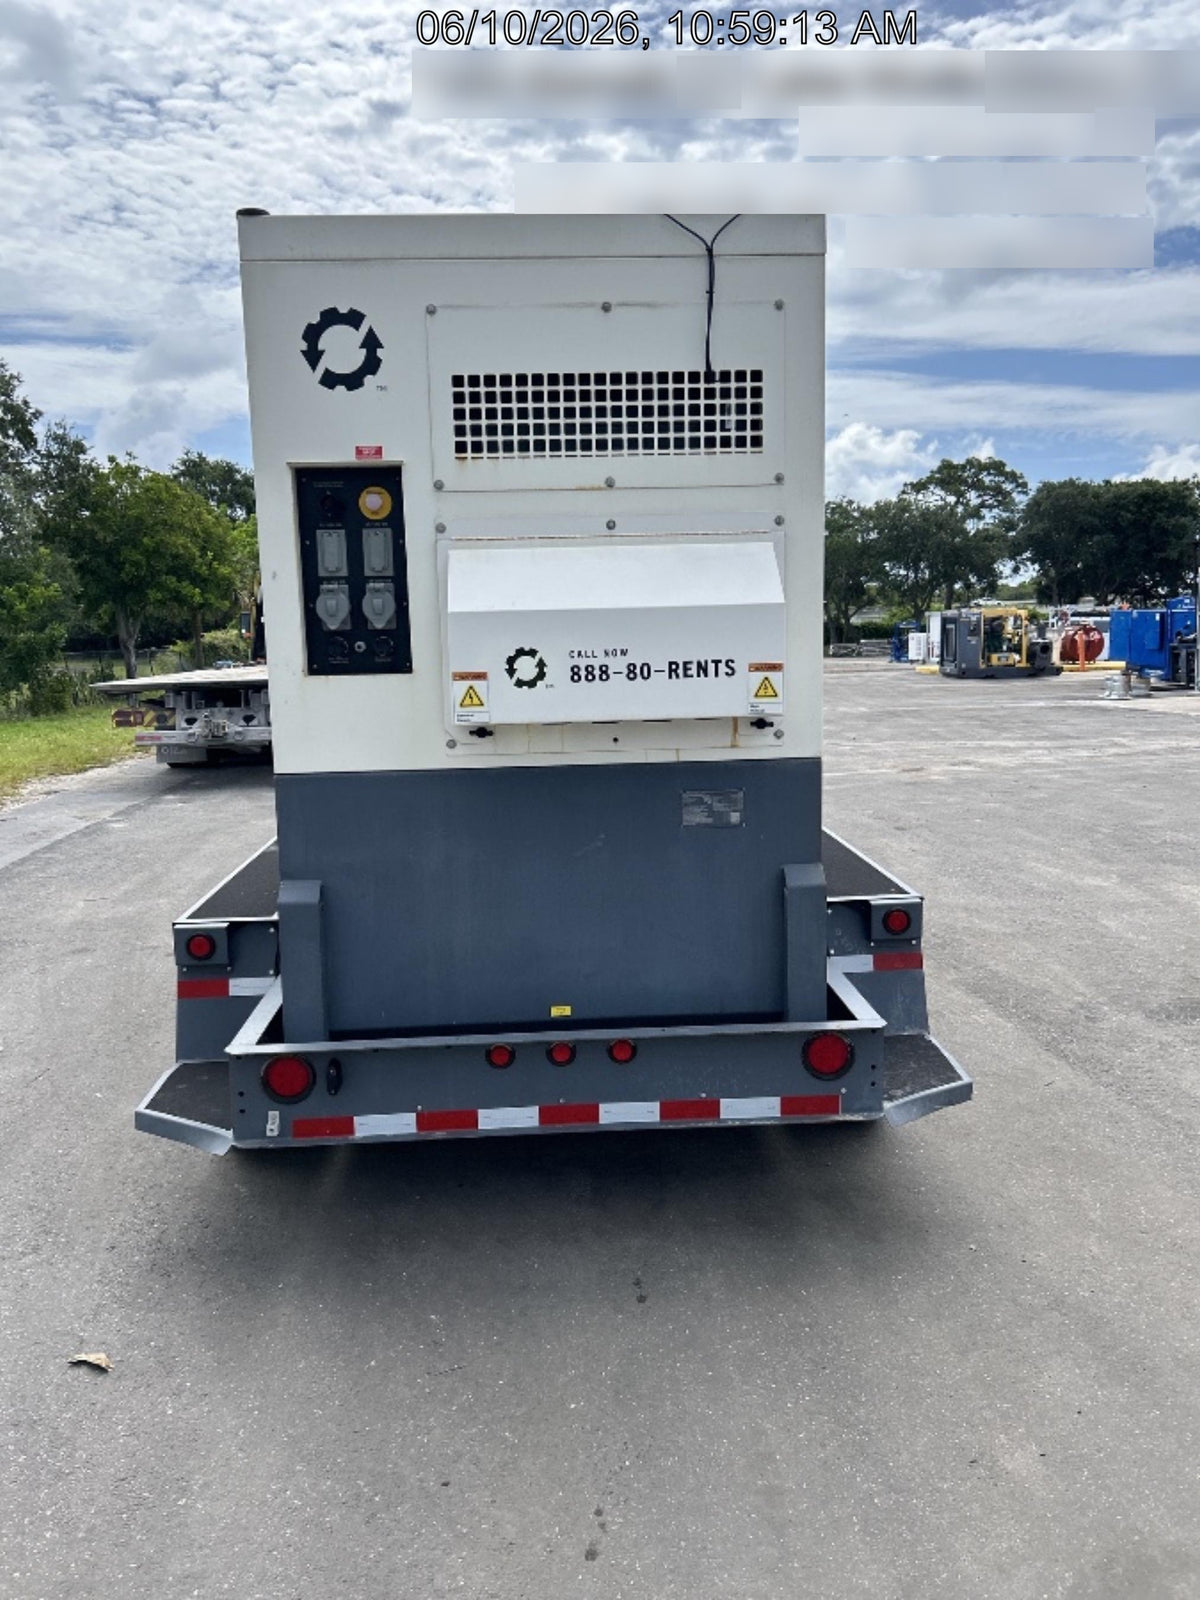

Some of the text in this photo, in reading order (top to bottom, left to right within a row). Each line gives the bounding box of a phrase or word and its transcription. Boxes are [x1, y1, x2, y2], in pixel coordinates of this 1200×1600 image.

[568, 648, 629, 659] CALL NOW
[569, 658, 737, 684] 888-80-RENTS
